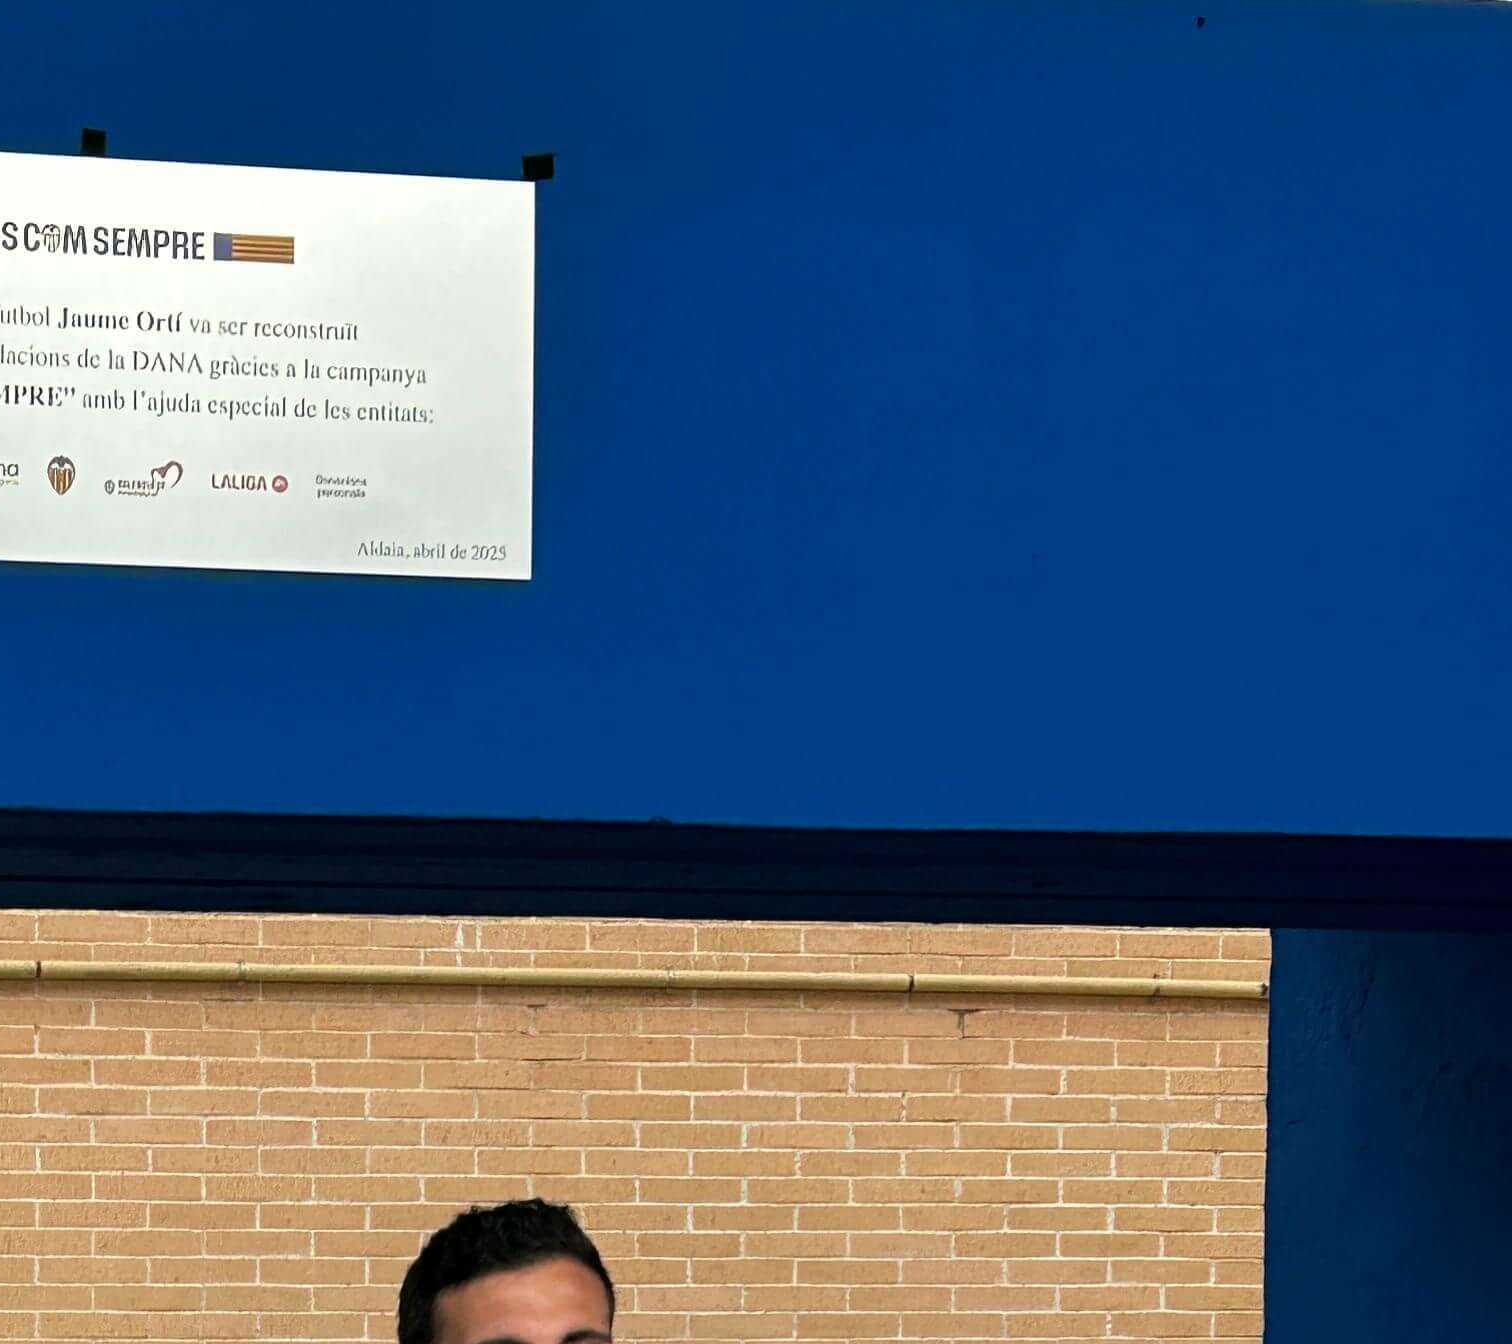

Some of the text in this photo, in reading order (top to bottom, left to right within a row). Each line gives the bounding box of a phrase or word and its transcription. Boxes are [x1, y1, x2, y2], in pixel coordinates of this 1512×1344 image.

[57, 307, 129, 331] Jaume
[137, 310, 181, 332] Ortí
[189, 317, 210, 334] va
[218, 320, 248, 336] ser
[77, 348, 100, 369] de
[109, 349, 125, 370] la
[132, 350, 203, 374] DANA
[209, 355, 279, 380] gràcies
[286, 361, 296, 379] a
[304, 357, 320, 379] la
[327, 363, 426, 388] campanya
[82, 388, 125, 410] amb
[208, 392, 286, 420] especial
[294, 397, 316, 418] de
[325, 398, 351, 421] les
[450, 543, 467, 560] de
